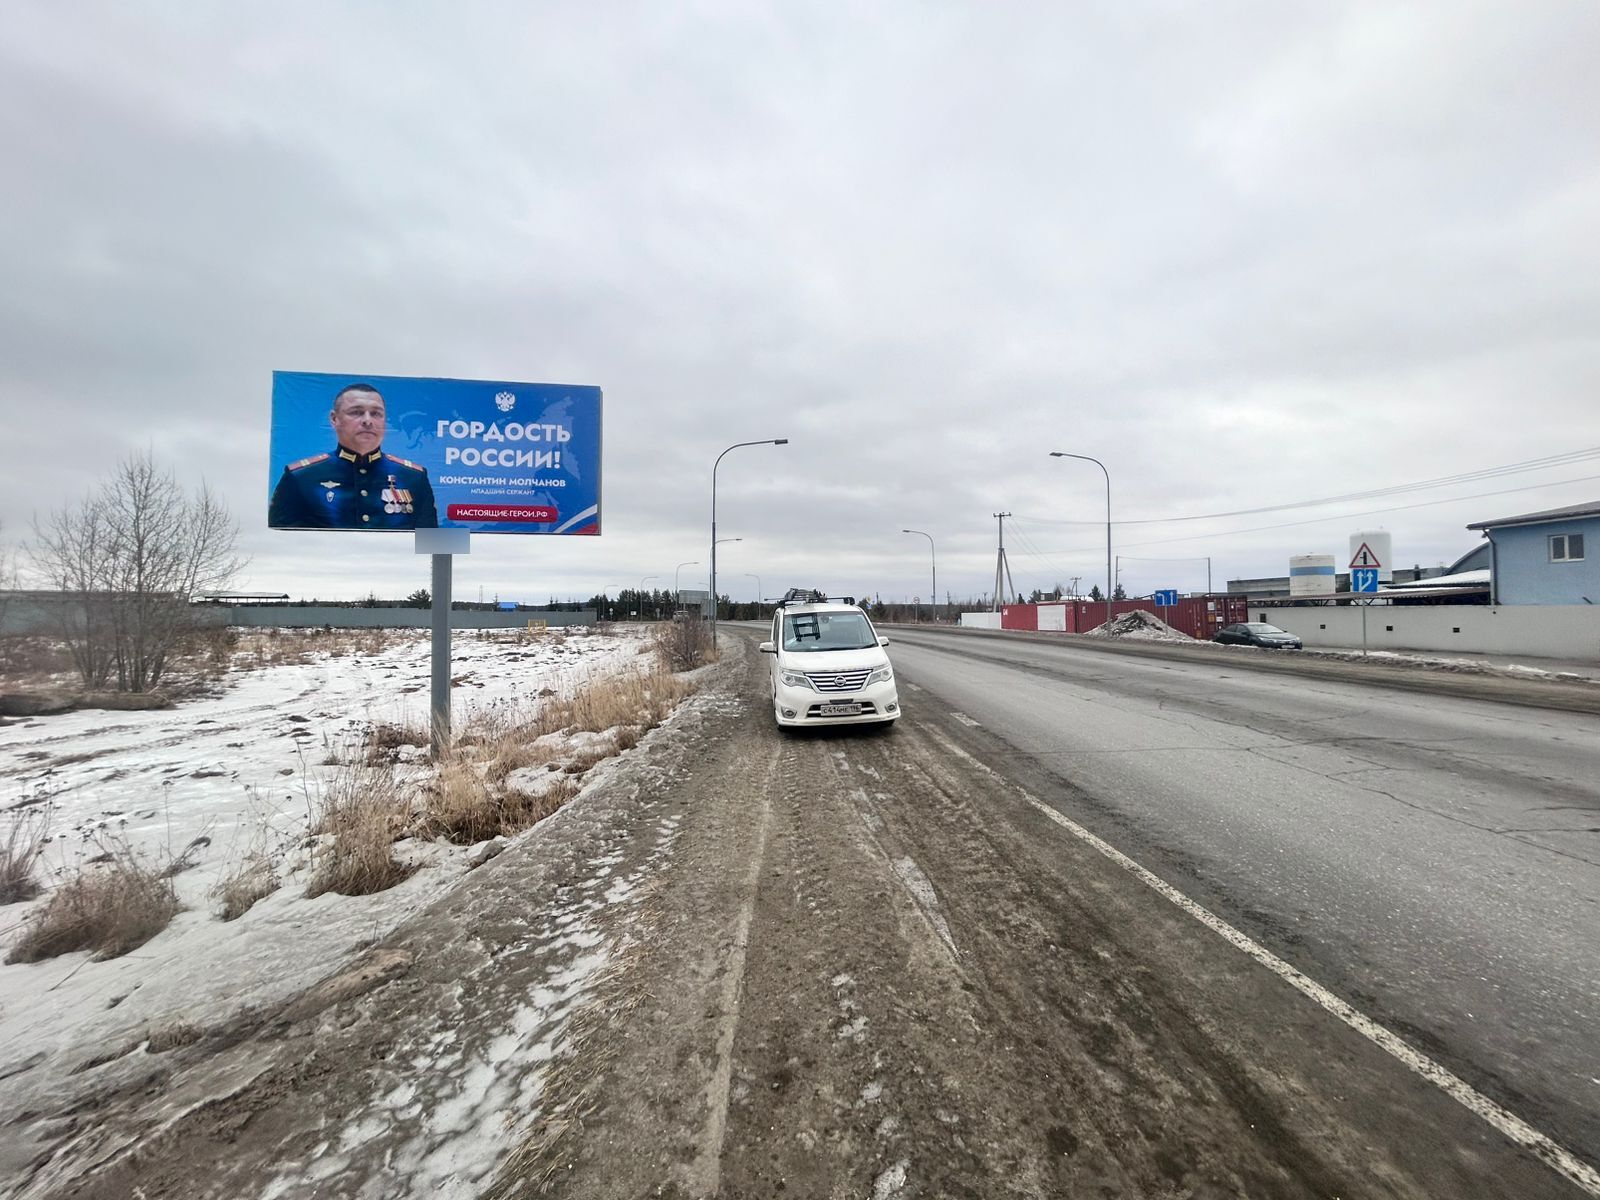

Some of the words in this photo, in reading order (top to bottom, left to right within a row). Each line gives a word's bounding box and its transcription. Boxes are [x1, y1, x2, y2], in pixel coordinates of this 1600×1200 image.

[437, 420, 571, 442] ГОРДОСТЬ
[445, 447, 560, 469] РОССИИ!
[440, 475, 506, 485] КОНСТАНТИН
[509, 477, 566, 488] МОЛЧАНОВ
[456, 509, 548, 518] НАСТОЯЩИЕ-ГЕРОИ.РФ
